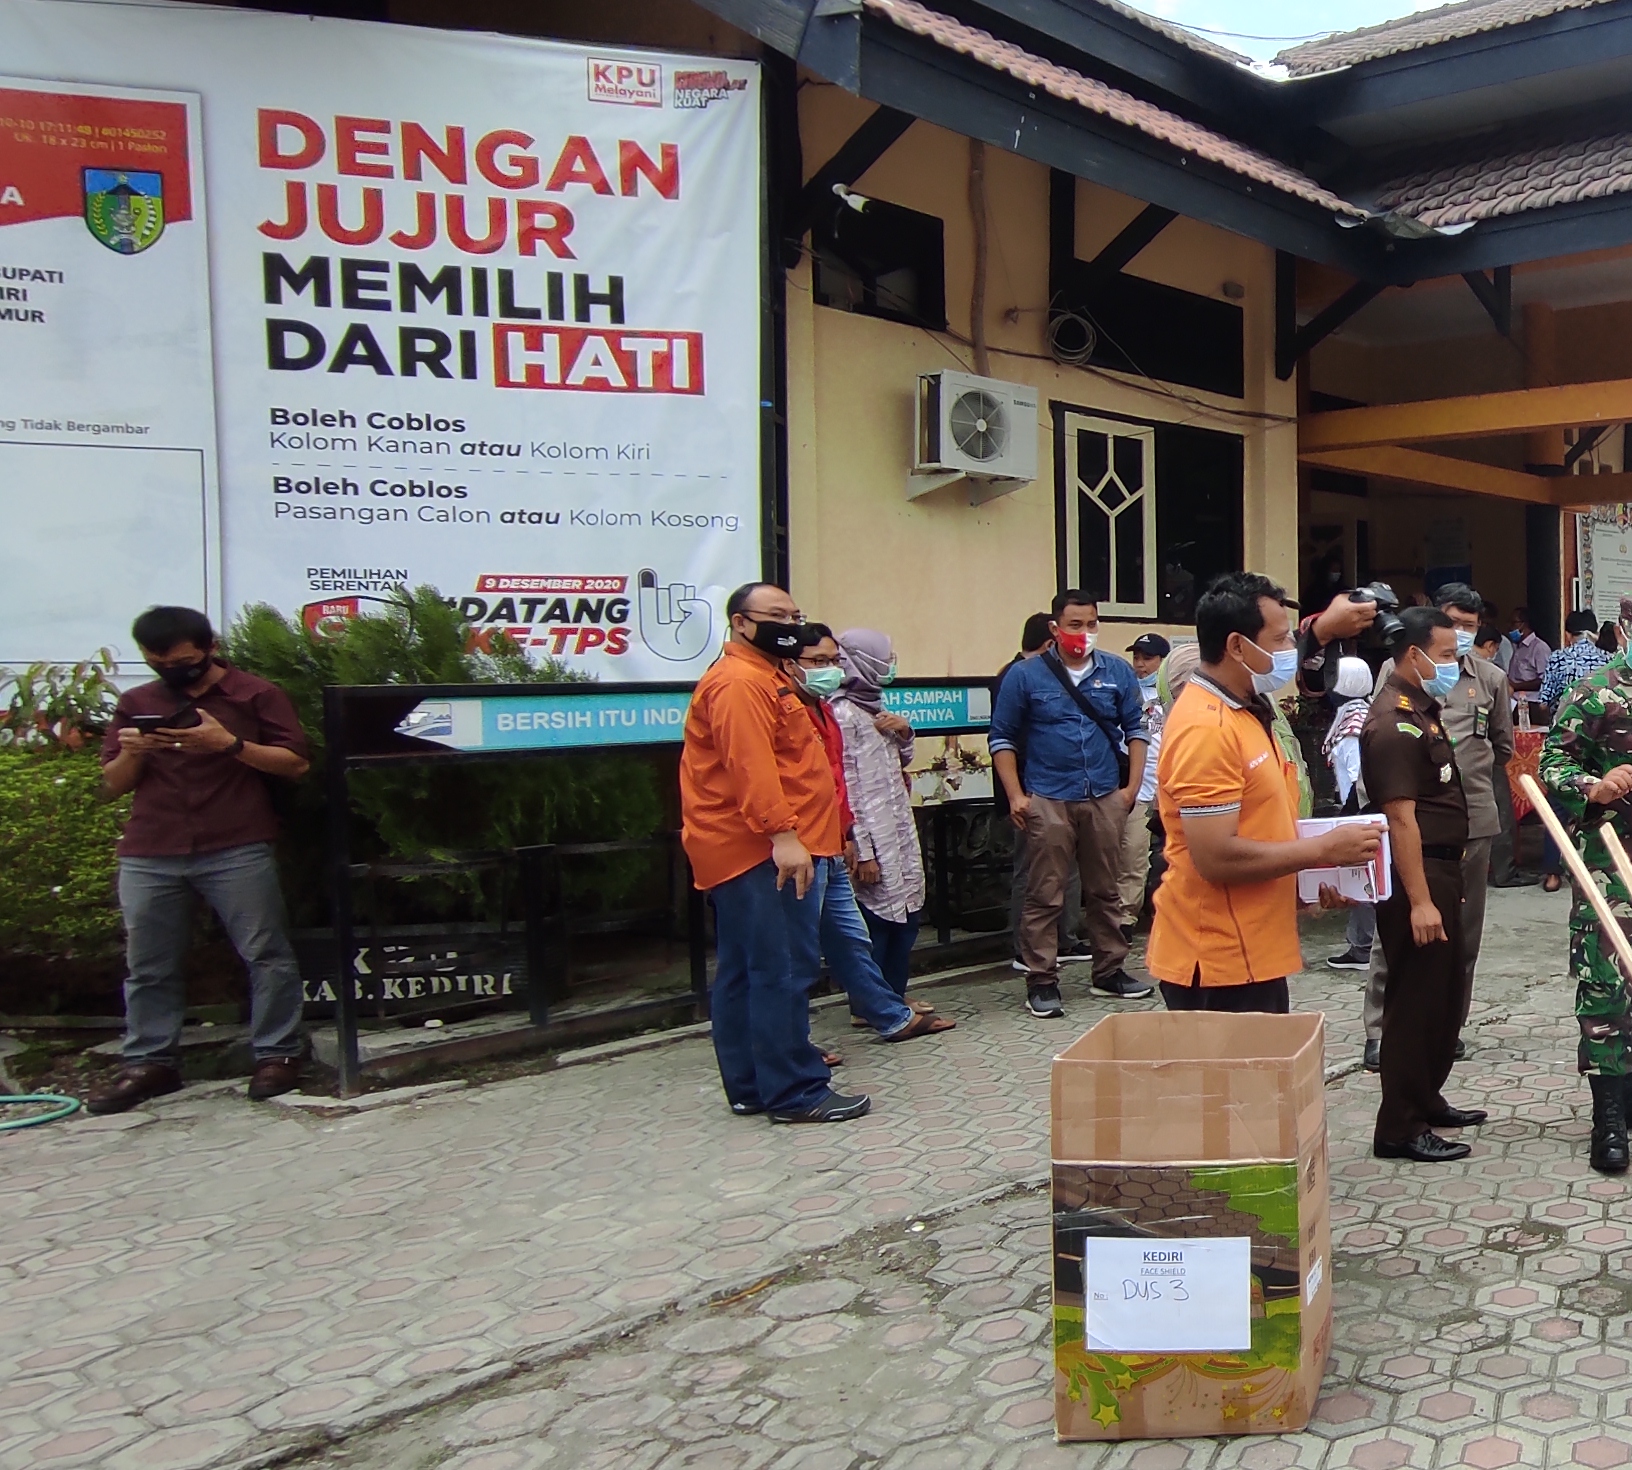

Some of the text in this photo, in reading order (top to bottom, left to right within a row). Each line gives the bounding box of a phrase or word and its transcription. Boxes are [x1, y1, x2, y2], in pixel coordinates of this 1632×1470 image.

[593, 63, 655, 88] KPU
[594, 83, 656, 99] Melayani
[675, 88, 729, 99] NEGARA
[674, 97, 708, 108] KUAT
[257, 108, 679, 200] DENGAN
[256, 180, 578, 260] JUJUR
[0, 267, 64, 284] UPATI
[262, 251, 626, 324] MEMILIH
[265, 317, 690, 389] DARI HATI
[21, 419, 62, 432] Tidak
[67, 421, 150, 435] Bergambar
[270, 407, 466, 433] Boleh Coblos
[269, 431, 650, 460] Kolom Kanan atau Kolom Kiri
[273, 476, 468, 499] Boleh Coblos
[274, 501, 739, 532] Pasangan Calon atau Kolom Kosong
[307, 567, 408, 580] PEMILIHAN
[484, 577, 620, 590] 9 DESEMBER 2020
[309, 580, 406, 592] SERENTAK
[904, 690, 962, 705] SAMPAH
[496, 711, 592, 731] BERSIH
[600, 709, 636, 727] ITU
[382, 972, 513, 1000] KEDIRI
[1143, 1251, 1183, 1263] KEDIRI
[1140, 1267, 1186, 1276] FACE SHIELD
[1169, 1279, 1190, 1301] 3
